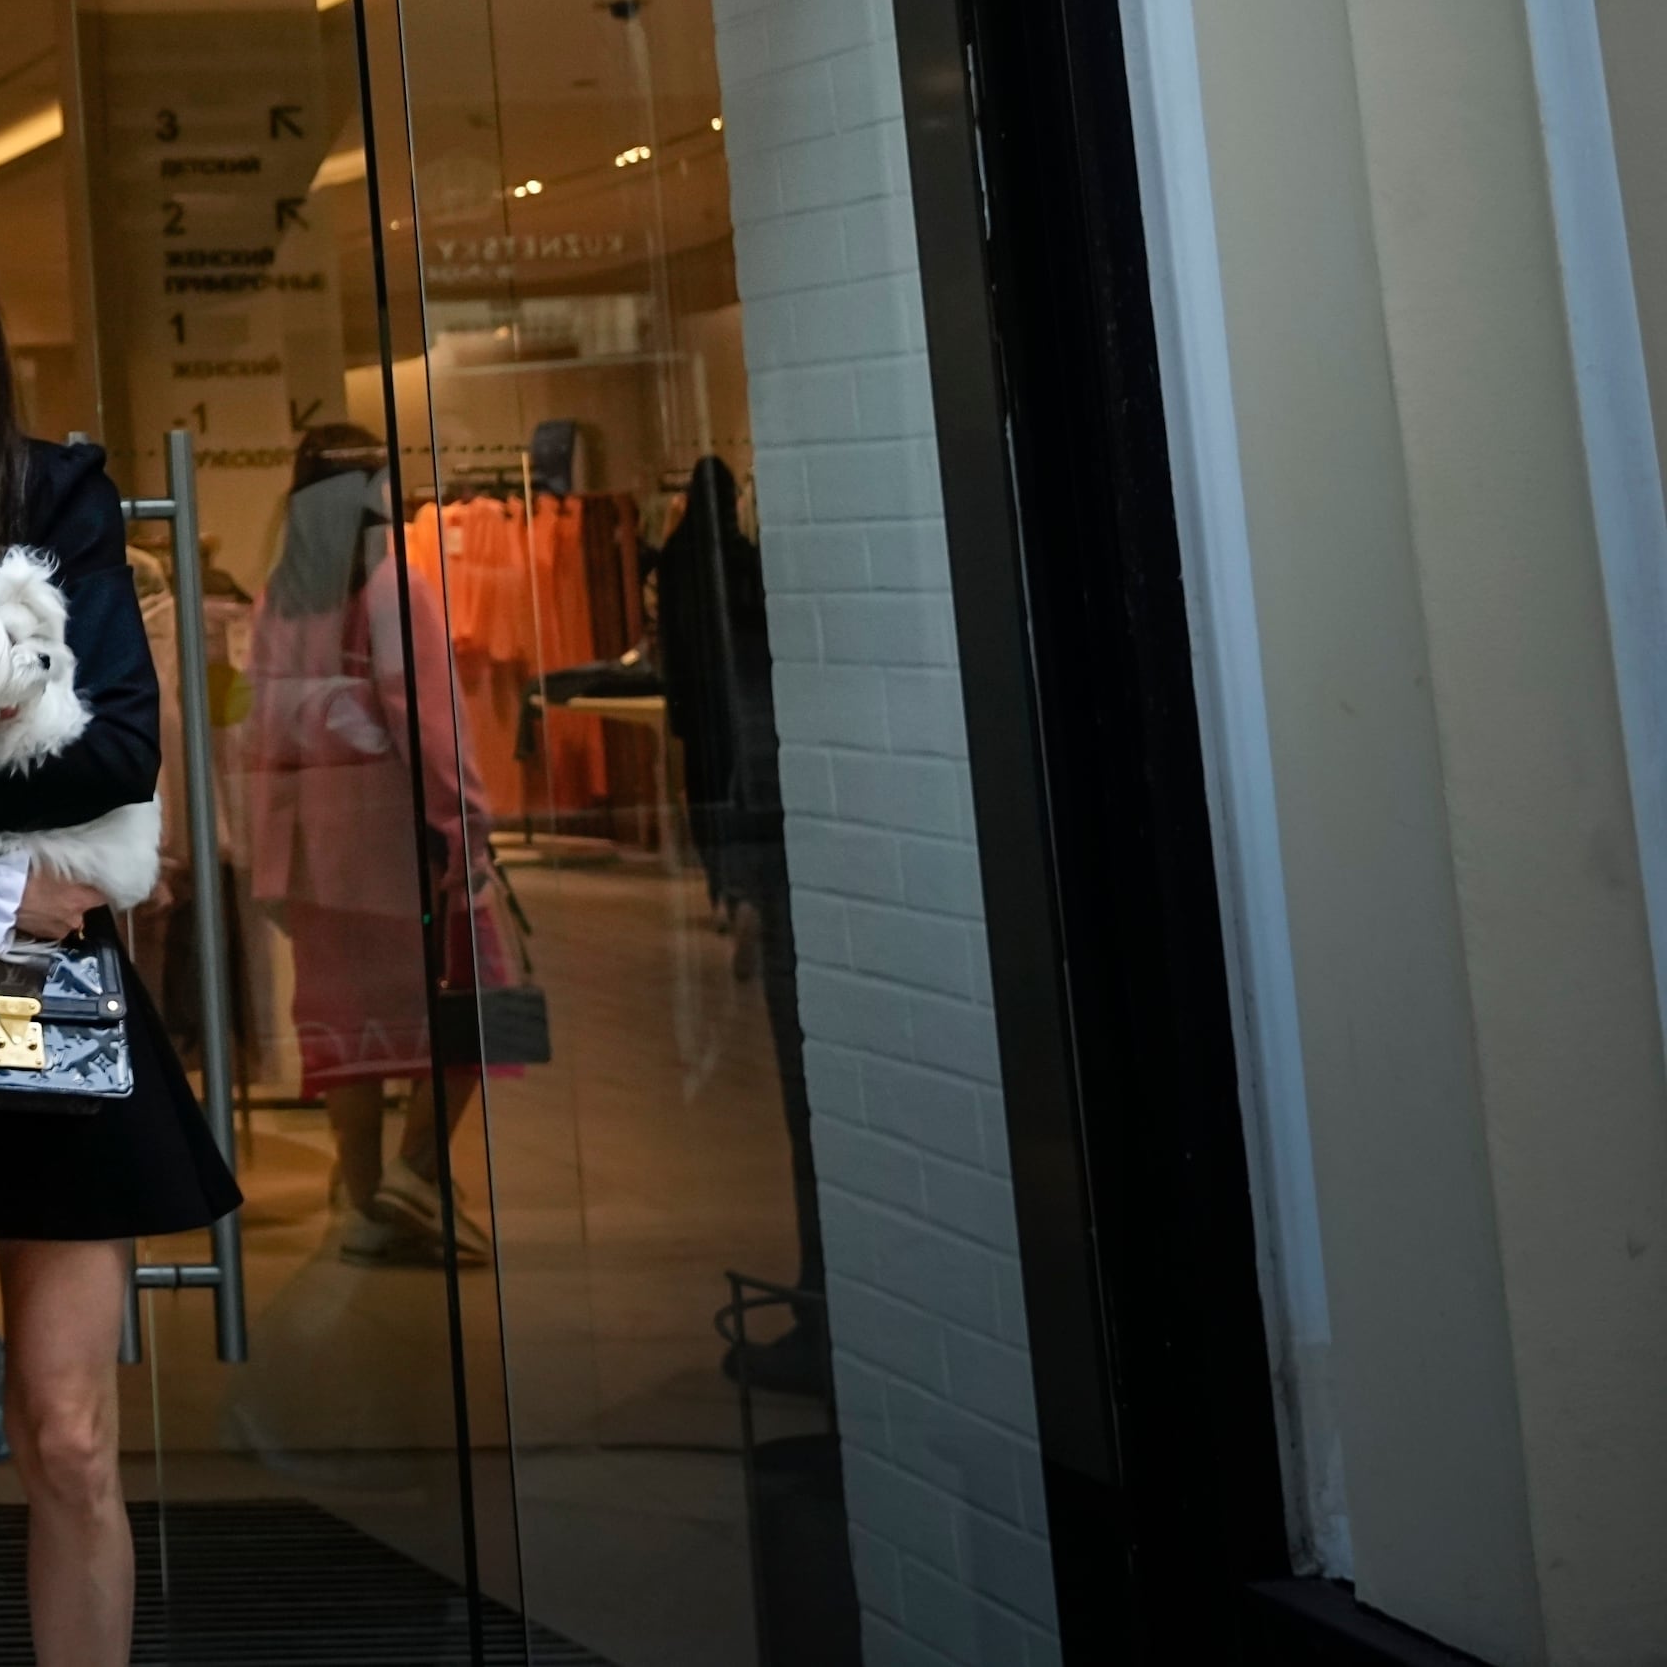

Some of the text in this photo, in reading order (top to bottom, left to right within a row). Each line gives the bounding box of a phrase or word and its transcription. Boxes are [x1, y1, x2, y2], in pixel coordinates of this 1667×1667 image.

[156, 108, 179, 142] 3
[162, 200, 185, 235] 2
[165, 246, 274, 267] ЖЕНСКИЙ
[169, 312, 185, 345] 1
[172, 354, 281, 378] ЖЕНСКИЙ
[173, 401, 207, 433] -1
[195, 447, 289, 468] УЖСКОЙ
